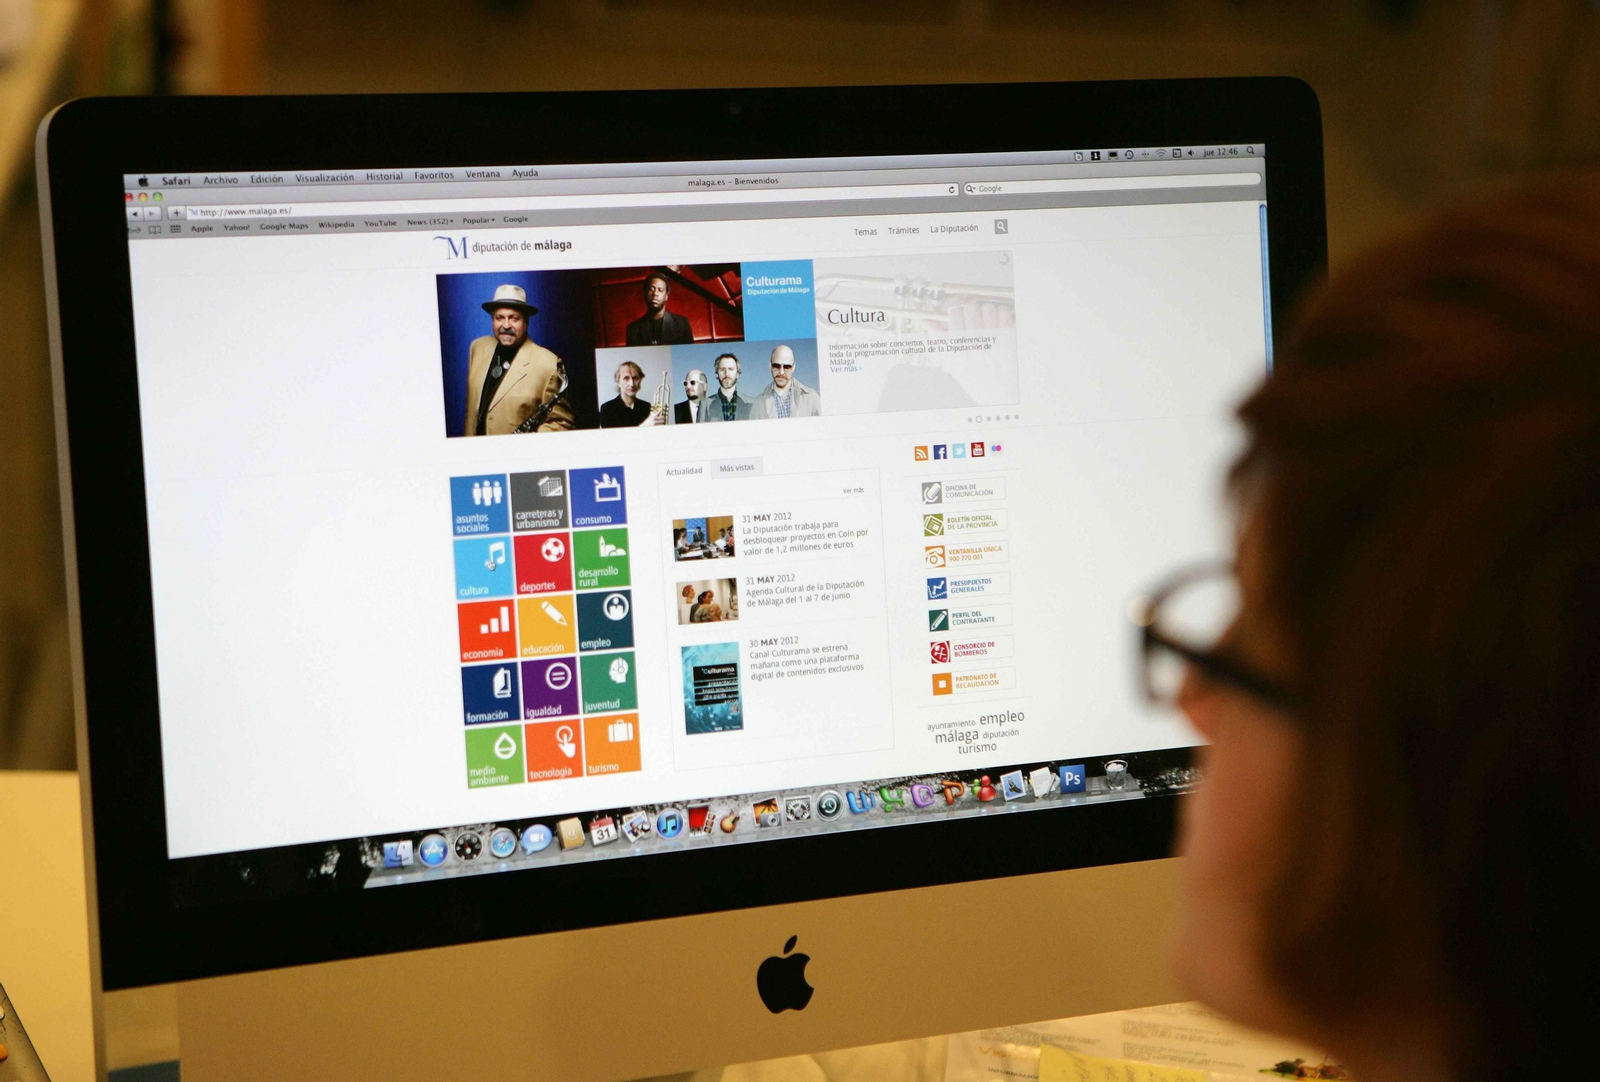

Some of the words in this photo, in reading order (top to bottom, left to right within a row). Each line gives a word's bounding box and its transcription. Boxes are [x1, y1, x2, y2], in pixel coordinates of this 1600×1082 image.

[1203, 150, 1215, 158] jue
[1217, 148, 1238, 156] 12:46
[162, 177, 191, 187] Safari
[203, 175, 239, 186] Archivo
[250, 173, 283, 185] Edición
[295, 173, 355, 184] Visualización
[366, 171, 404, 182] Historial
[414, 170, 454, 180] Favoritos
[465, 169, 500, 179] Ventana
[512, 168, 539, 179] Ayuda
[688, 177, 726, 188] malaga.es
[734, 176, 779, 186] Bienvenidos
[978, 184, 1002, 194] Google
[200, 207, 292, 217] http://www.malaga.es/
[191, 225, 214, 233] Apple
[260, 223, 286, 231] Google
[288, 222, 309, 230] Maps
[318, 221, 355, 230] Wikipedia
[364, 220, 398, 228] YouTube
[407, 218, 427, 226] News
[429, 218, 449, 227] (352)
[462, 217, 490, 226] Popular
[503, 215, 528, 224] Google
[854, 228, 878, 237] Temas
[888, 226, 920, 236] Trámites
[930, 224, 939, 234] La
[940, 224, 979, 235] Diputación
[472, 240, 518, 254] diputación
[520, 240, 532, 251] de
[534, 239, 572, 252] málaga
[746, 276, 802, 287] Culturama
[747, 288, 779, 296] Diputación
[788, 286, 810, 295] Málaga
[827, 308, 886, 325] Cultura
[829, 342, 869, 350] Información
[890, 340, 924, 348] conciertos,
[950, 336, 990, 344] conferencias
[846, 350, 852, 358] la
[854, 348, 900, 358] programación
[946, 344, 982, 352] Diputación
[830, 358, 855, 366] Málaga
[666, 466, 703, 476] Actualidad
[720, 464, 734, 472] Más
[736, 464, 754, 472] vistas
[456, 514, 488, 524] asuntos
[516, 510, 556, 520] carreteras
[558, 510, 564, 519] y
[576, 516, 612, 525] consumo
[742, 515, 752, 523] 31
[754, 514, 772, 522] MAY
[774, 512, 792, 521] 2012
[456, 522, 490, 533] sociales
[516, 518, 560, 529] urbanismo
[742, 526, 752, 534] La
[754, 523, 793, 535] Diputación
[795, 522, 820, 532] trabaja
[822, 521, 838, 530] para
[743, 534, 788, 548] desbloquear
[790, 532, 826, 544] proyectos
[838, 530, 854, 538] Coín
[856, 530, 868, 538] por
[744, 547, 762, 556] valor
[764, 546, 774, 554] de
[776, 544, 788, 555] 1,2
[790, 542, 821, 552] millones
[822, 542, 832, 550] de
[834, 540, 854, 550] euros
[578, 566, 618, 578] desarrollo
[579, 576, 598, 586] rural
[746, 577, 755, 586] 31
[757, 576, 775, 584] MAY
[777, 574, 796, 583] 2012
[950, 578, 992, 586] PRESUPUESTOS
[460, 586, 489, 596] cultura
[520, 582, 556, 594] deportes
[746, 586, 774, 598] Agenda
[775, 584, 804, 595] Cultural
[806, 584, 816, 592] de
[816, 582, 824, 591] la
[826, 580, 864, 592] Diputación
[950, 586, 984, 594] GENERALES
[746, 598, 756, 608] de
[758, 596, 784, 608] Málaga
[786, 595, 796, 604] del
[806, 594, 812, 602] al
[821, 592, 830, 602] de
[832, 592, 850, 602] junio
[952, 616, 996, 626] CONTRATANTE
[581, 638, 612, 650] empleo
[750, 640, 759, 648] 30
[760, 638, 779, 647] MAY
[780, 636, 800, 646] 2012
[954, 642, 986, 650] CONSORCIO
[463, 648, 504, 660] economía
[523, 644, 564, 655] educación
[750, 650, 770, 660] Canal
[772, 647, 810, 658] Culturama
[812, 646, 820, 654] se
[822, 644, 848, 652] estrena
[954, 649, 988, 657] BOMBEROS
[750, 660, 780, 670] mañana
[782, 659, 802, 668] como
[804, 658, 818, 666] una
[820, 653, 860, 666] plataforma
[750, 670, 774, 682] digital
[776, 669, 785, 678] de
[786, 666, 826, 677] contenidos
[828, 664, 864, 674] exclusivos
[956, 674, 988, 682] PATRONATO
[585, 698, 620, 712] juventud
[466, 710, 508, 722] formación
[526, 704, 562, 720] igualdad
[928, 720, 976, 730] ayuntamiento
[980, 710, 1025, 727] empleo
[936, 730, 979, 744] málaga
[983, 729, 1020, 740] diputación
[958, 743, 997, 754] turismo
[470, 766, 496, 776] medio
[530, 766, 572, 780] tecnología
[588, 764, 619, 773] turismo
[470, 774, 509, 786] ambiente
[1064, 772, 1081, 787] Ps
[597, 827, 610, 840] 31
